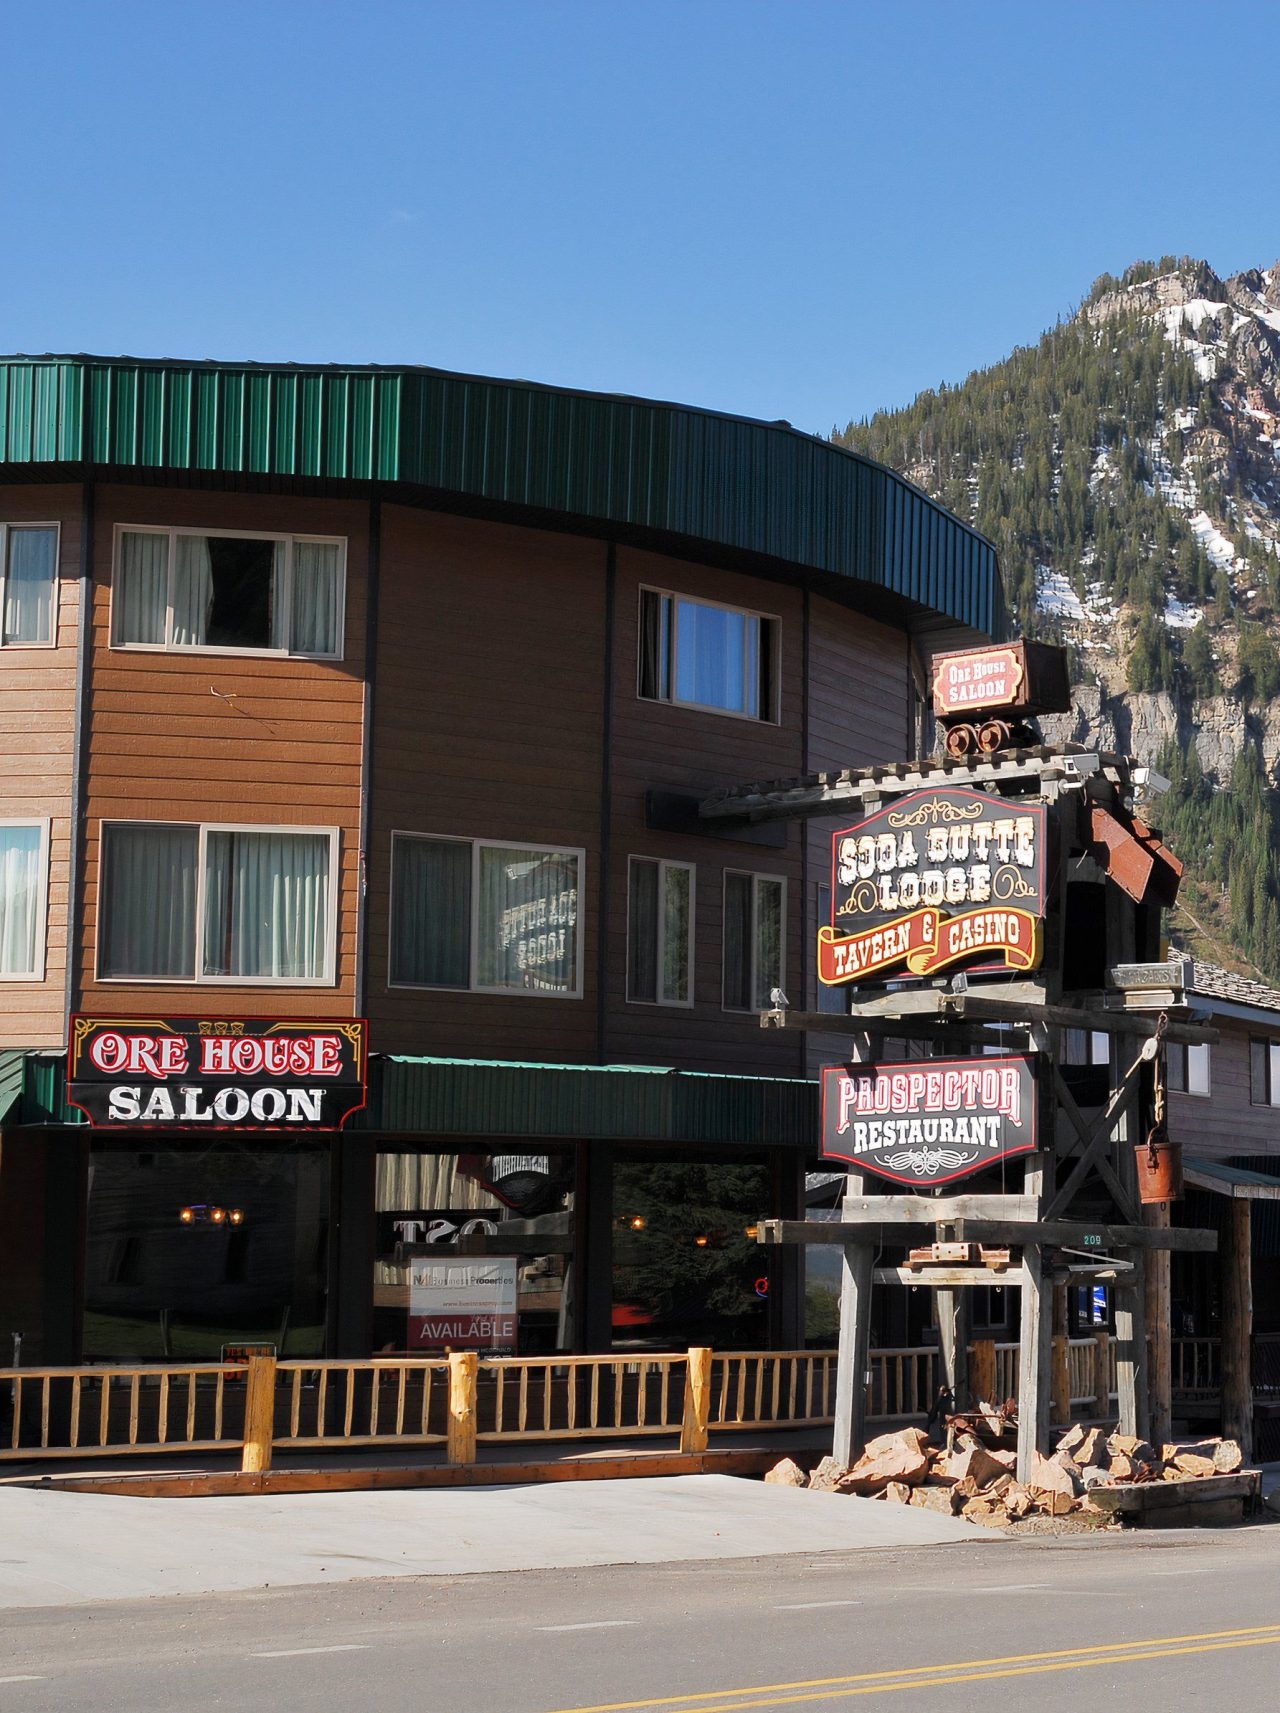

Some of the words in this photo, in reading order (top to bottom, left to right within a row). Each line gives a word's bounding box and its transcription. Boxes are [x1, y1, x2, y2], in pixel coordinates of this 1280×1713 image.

[973, 660, 1006, 680] HOUSE
[949, 679, 1006, 704] SALOON
[838, 831, 919, 886] SODA
[926, 816, 1035, 868] BUTTE
[877, 864, 991, 911] LODGE
[833, 921, 912, 976] TAVERN
[922, 914, 933, 943] &
[948, 913, 1021, 954] CASINO
[90, 1031, 189, 1079] ORE
[199, 1033, 343, 1077] HOUSE
[108, 1086, 327, 1121] SALOON
[836, 1068, 1023, 1135] PROSPECTOR
[853, 1115, 1002, 1155] RESTAURANT
[1084, 1235, 1101, 1246] 209
[420, 1321, 513, 1339] AVAILABLE
